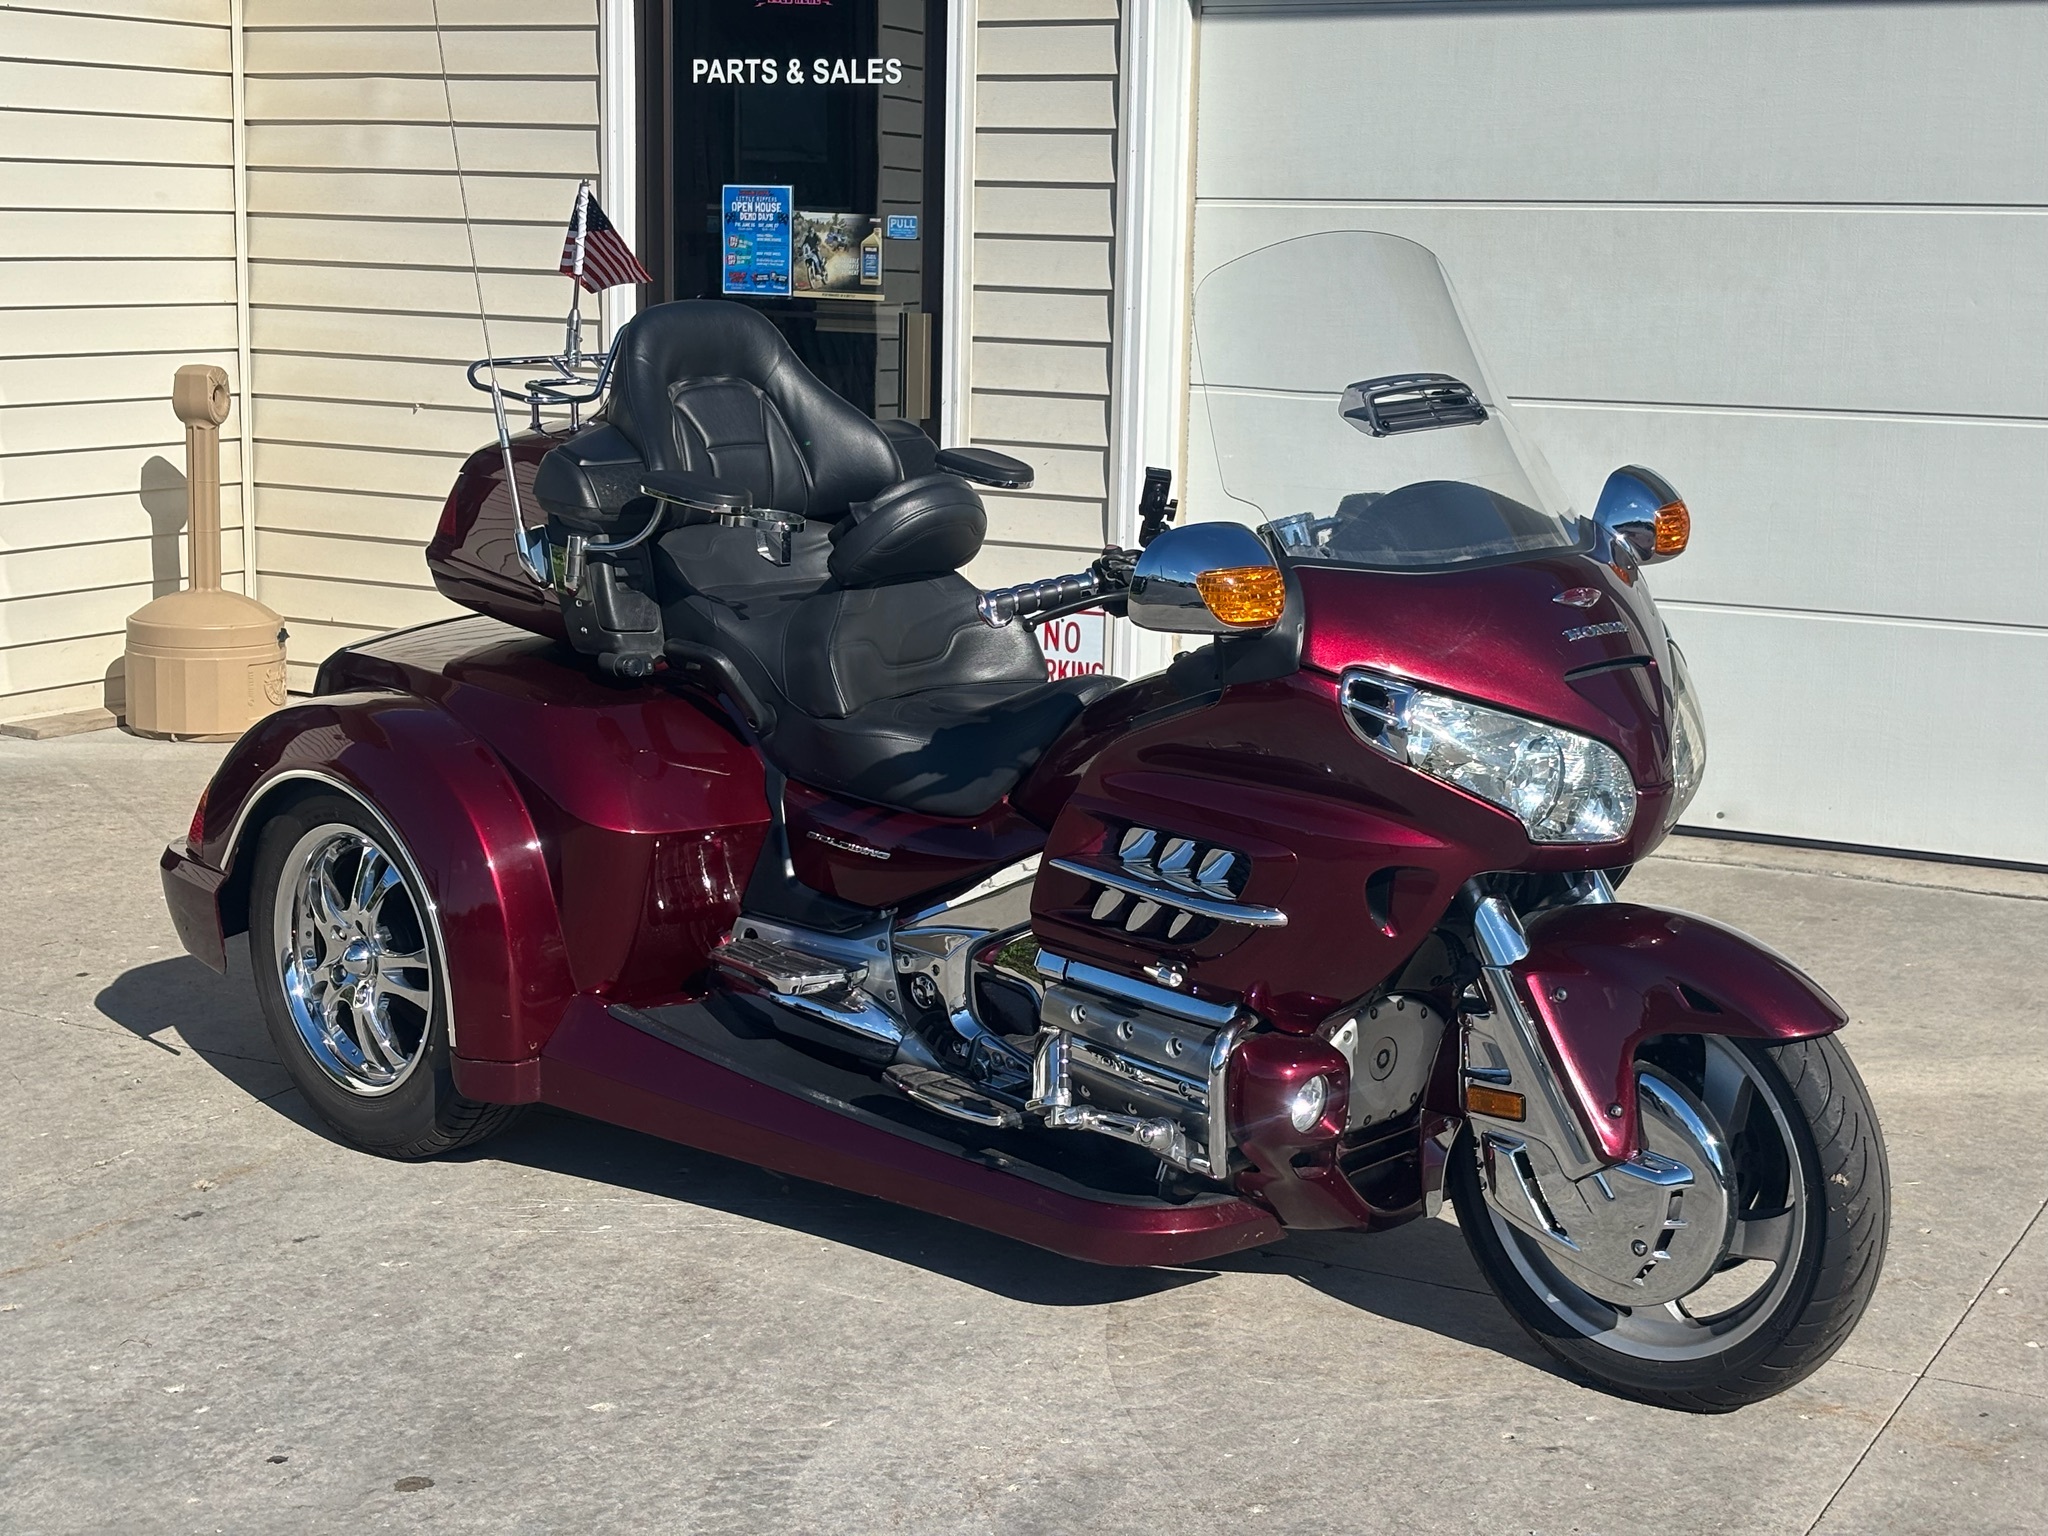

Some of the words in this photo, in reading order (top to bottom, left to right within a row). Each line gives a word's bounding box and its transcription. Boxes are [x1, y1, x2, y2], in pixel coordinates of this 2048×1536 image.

[692, 58, 778, 84] PARTS
[786, 58, 805, 84] &
[813, 58, 902, 84] SALES
[731, 202, 753, 212] OPEN
[755, 202, 782, 212] HOUSE
[740, 212, 757, 220] DEMO
[758, 213, 774, 221] DAYS
[890, 218, 916, 228] PULL
[1044, 621, 1081, 653] NO
[1561, 621, 1629, 643] HONDA
